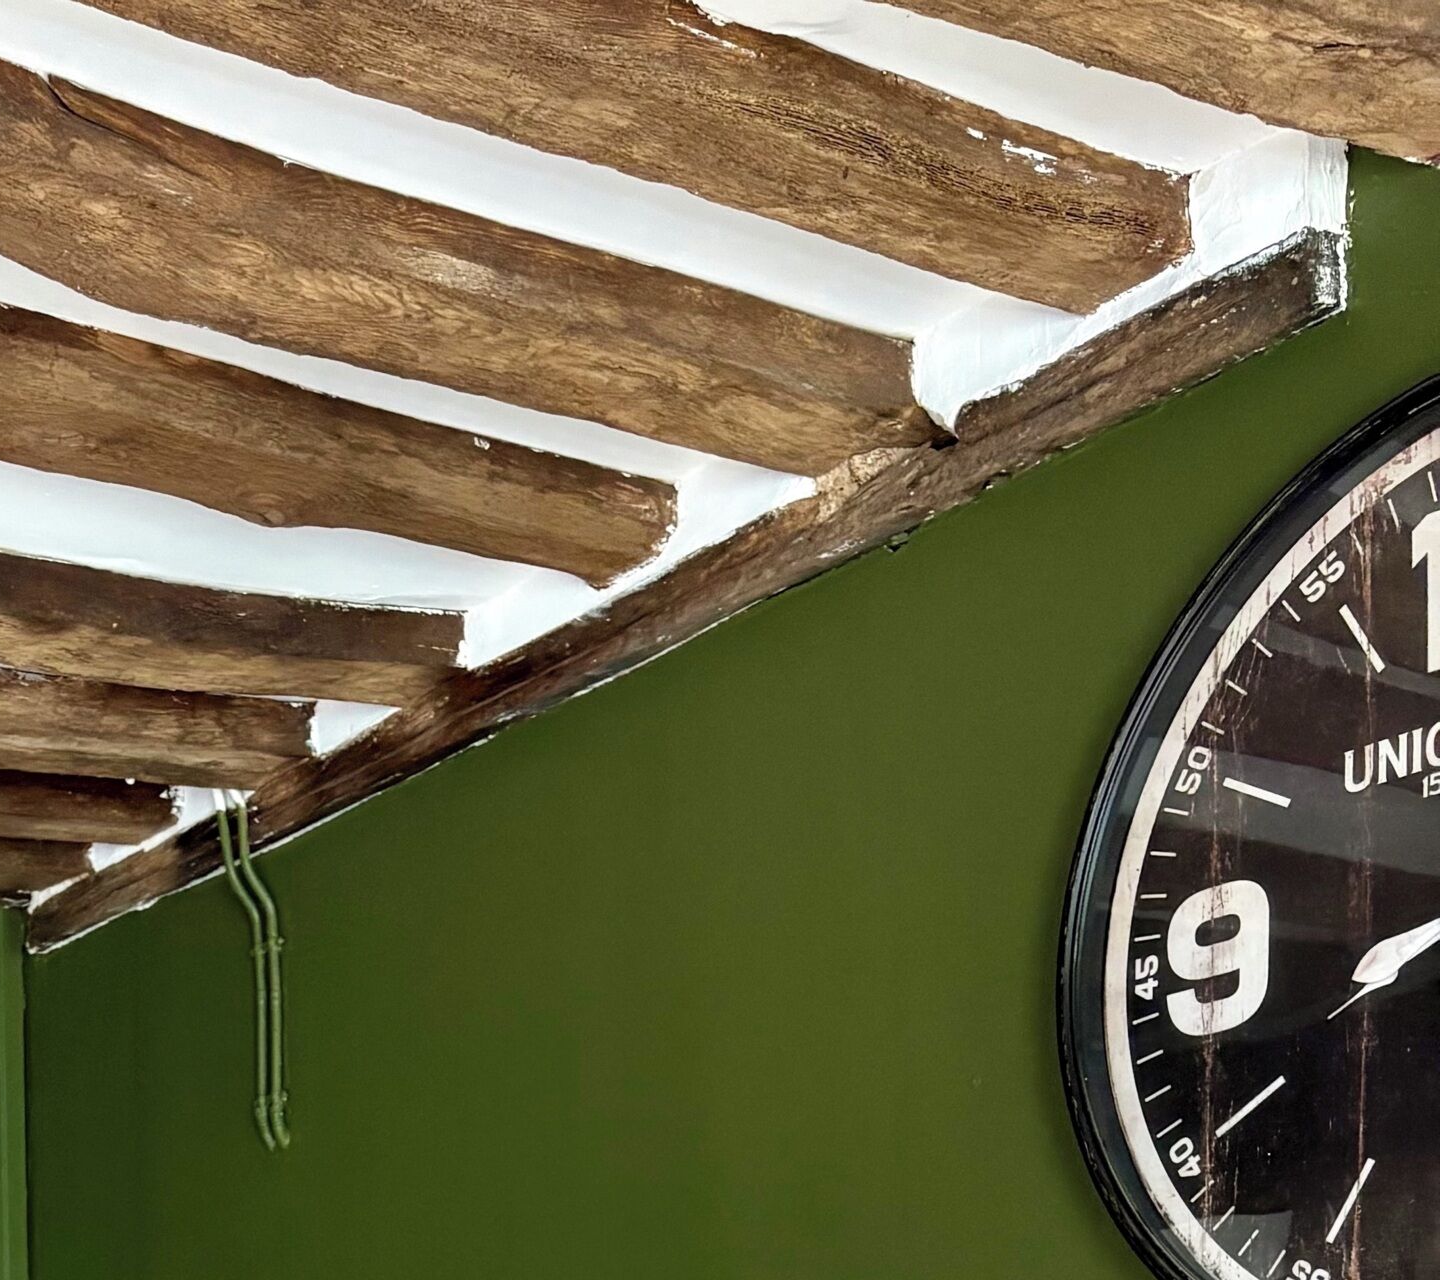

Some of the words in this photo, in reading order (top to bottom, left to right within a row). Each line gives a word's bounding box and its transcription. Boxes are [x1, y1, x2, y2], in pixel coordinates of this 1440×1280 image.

[1299, 551, 1346, 603] 55
[1175, 746, 1213, 795] 50
[1134, 954, 1159, 1001] 45
[1166, 879, 1270, 1037] 9
[1169, 1136, 1202, 1178] 40
